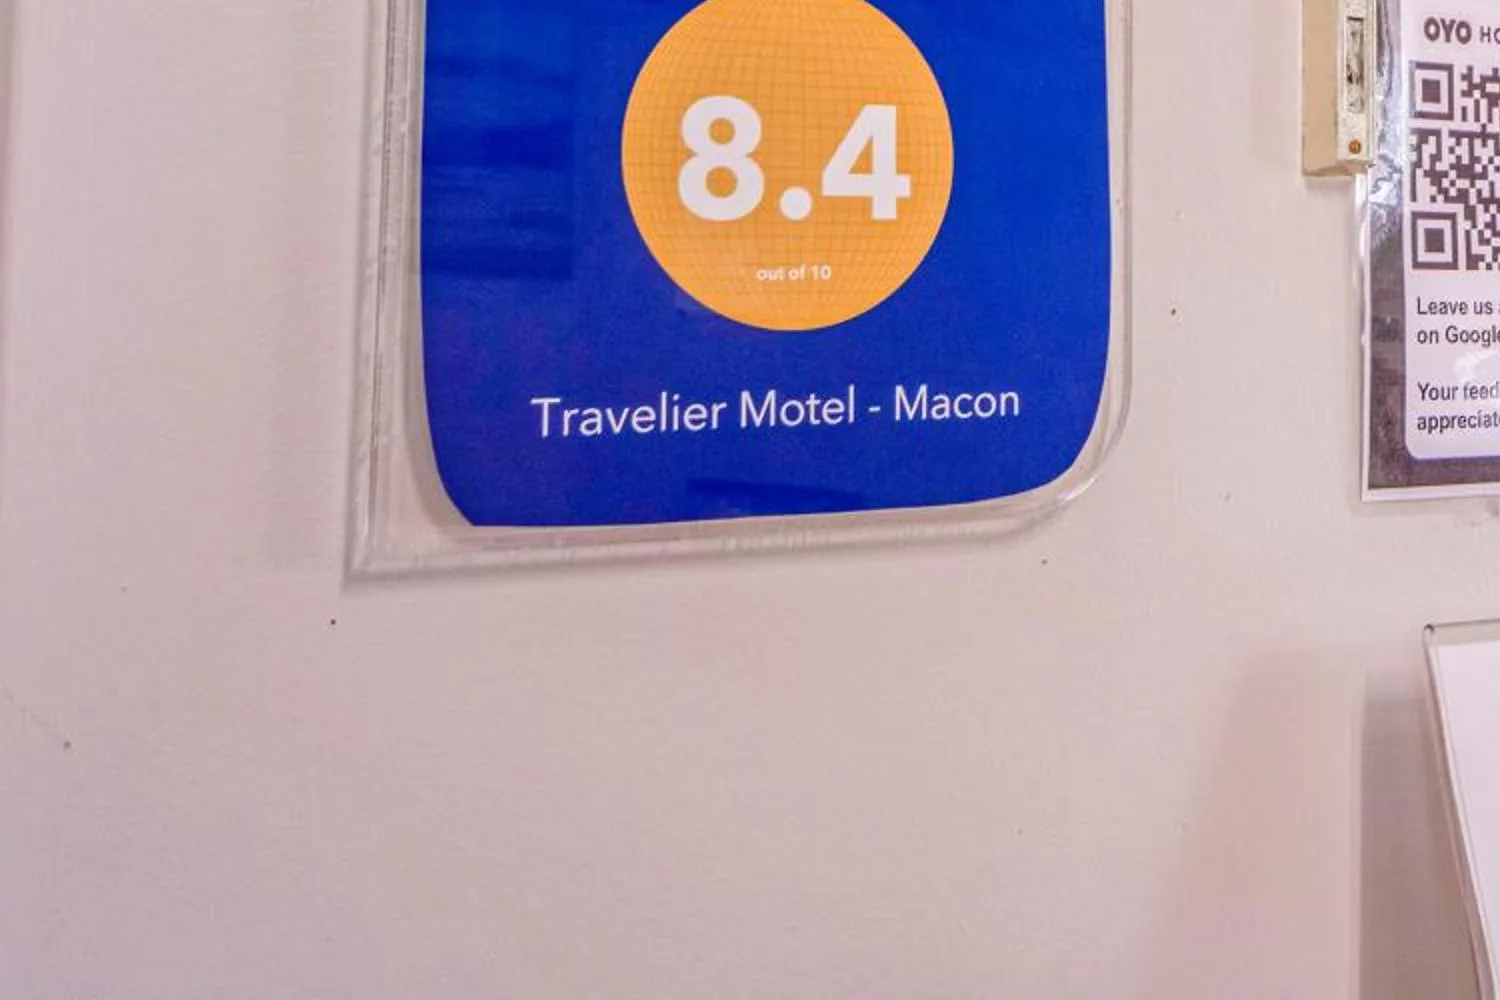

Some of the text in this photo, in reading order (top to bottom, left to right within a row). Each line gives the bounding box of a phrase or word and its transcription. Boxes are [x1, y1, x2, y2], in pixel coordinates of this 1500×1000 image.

[1423, 16, 1473, 45] OYO
[676, 94, 912, 221] 8.4
[756, 263, 832, 282] out of 10
[1416, 296, 1469, 317] Leave
[1473, 299, 1494, 316] us
[1416, 329, 1440, 345] on
[1416, 381, 1459, 402] Your
[531, 390, 727, 439] Travelier
[740, 385, 856, 429] Motel
[893, 383, 1021, 422] Macon
